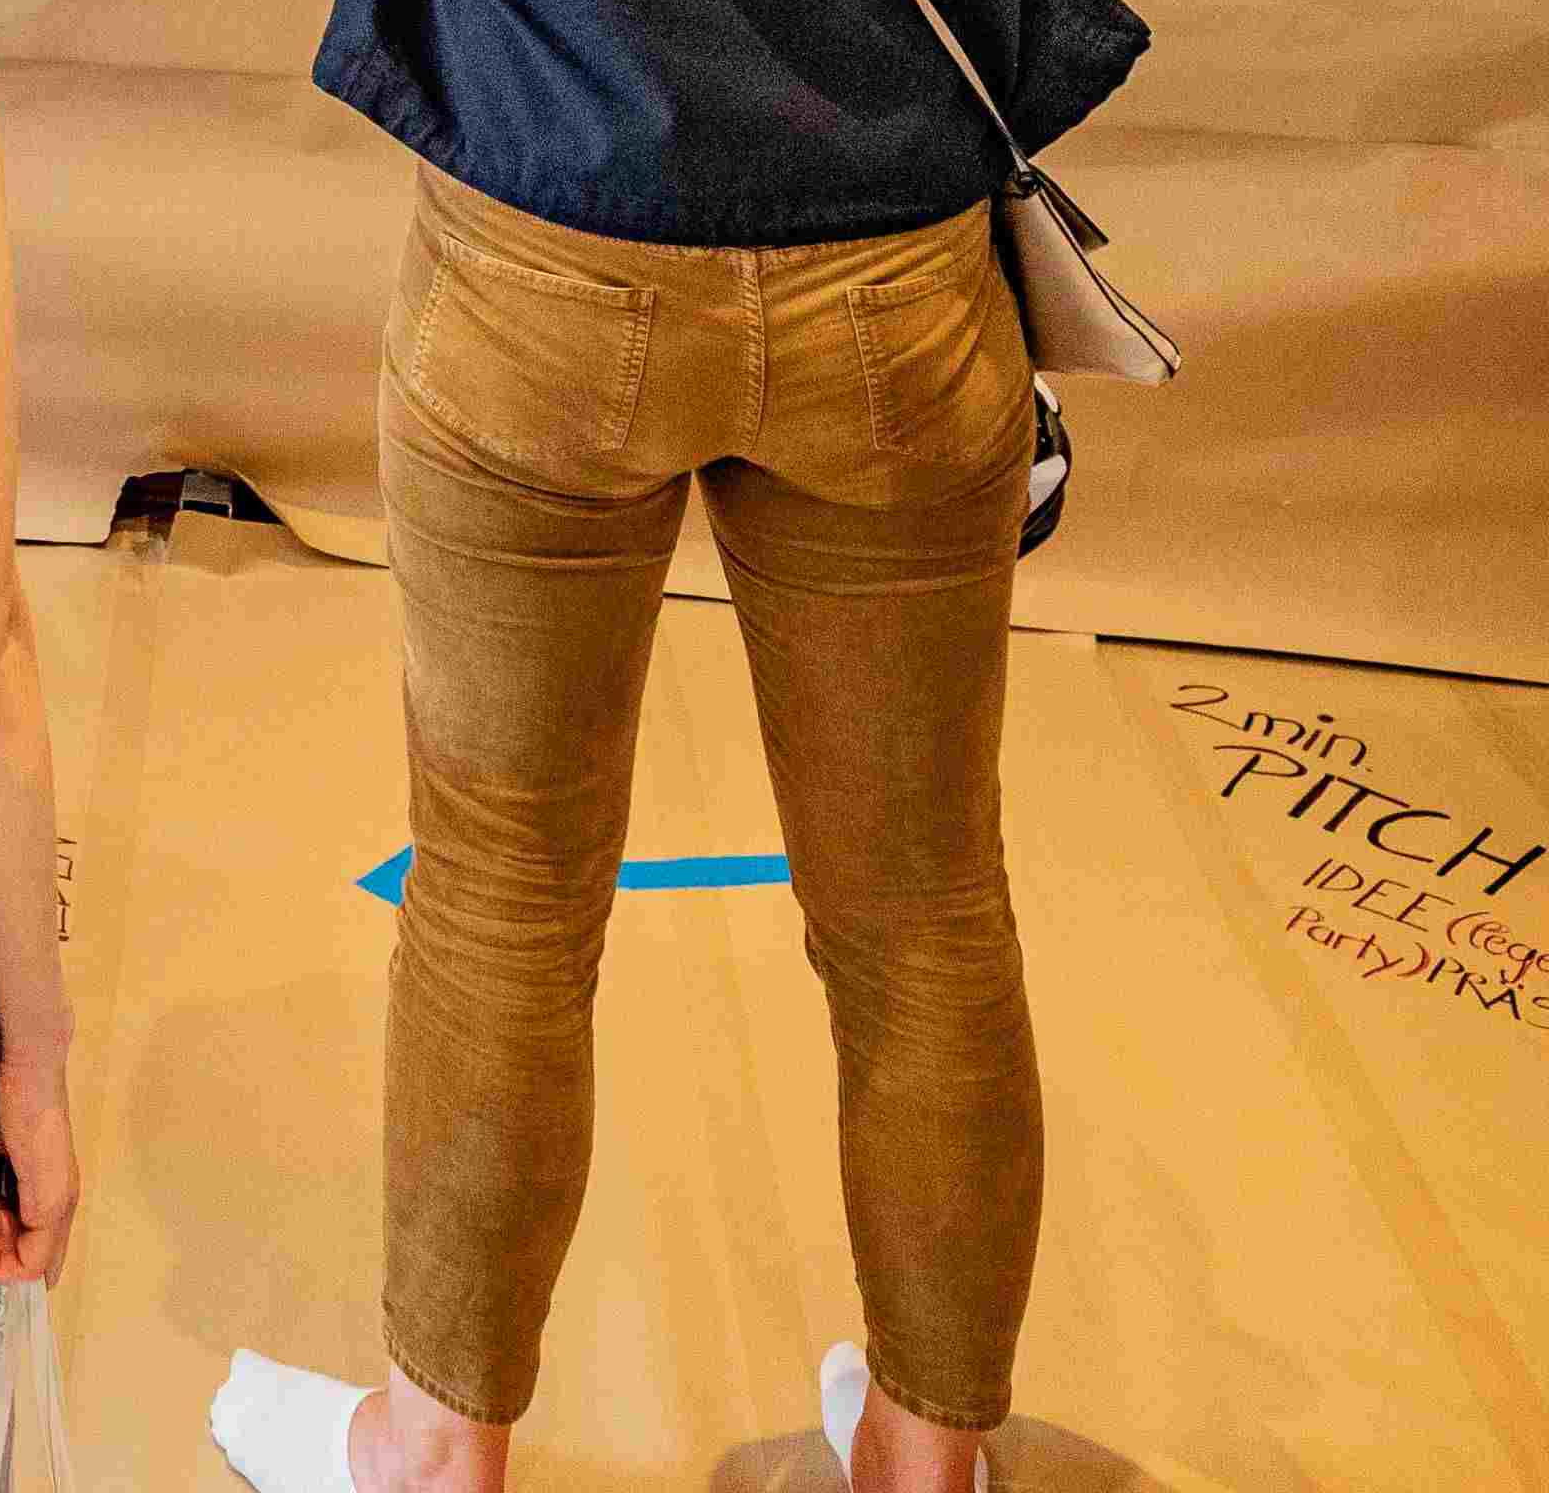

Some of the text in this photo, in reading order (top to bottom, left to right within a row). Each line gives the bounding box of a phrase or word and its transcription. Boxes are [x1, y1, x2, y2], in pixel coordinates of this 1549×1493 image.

[1170, 684, 1249, 733] 2
[1213, 744, 1548, 897] PITCH
[1302, 858, 1457, 936] IDEE
